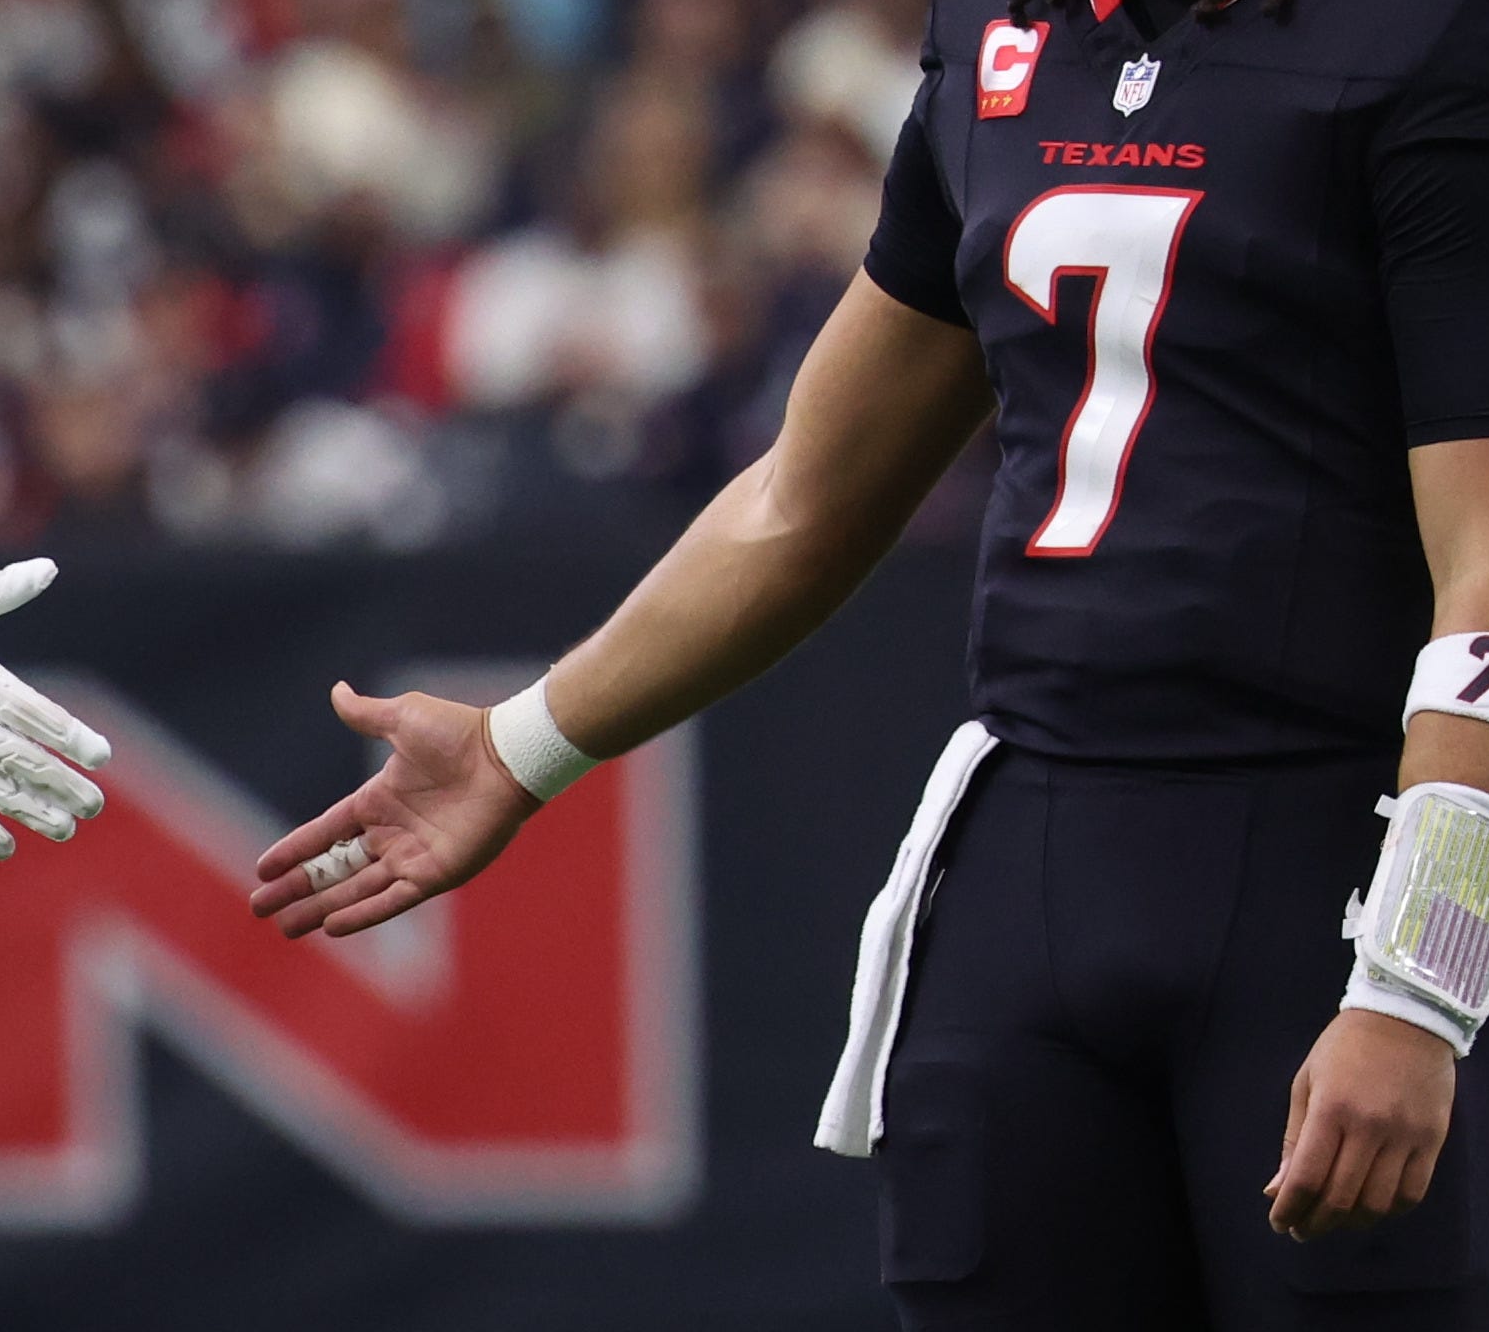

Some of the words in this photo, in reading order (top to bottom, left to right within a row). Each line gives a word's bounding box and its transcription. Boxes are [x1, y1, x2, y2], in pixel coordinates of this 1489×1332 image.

[980, 25, 1039, 93] C
[1120, 81, 1145, 102] NFL
[1039, 141, 1207, 168] TEXANS
[1004, 183, 1205, 556] 7
